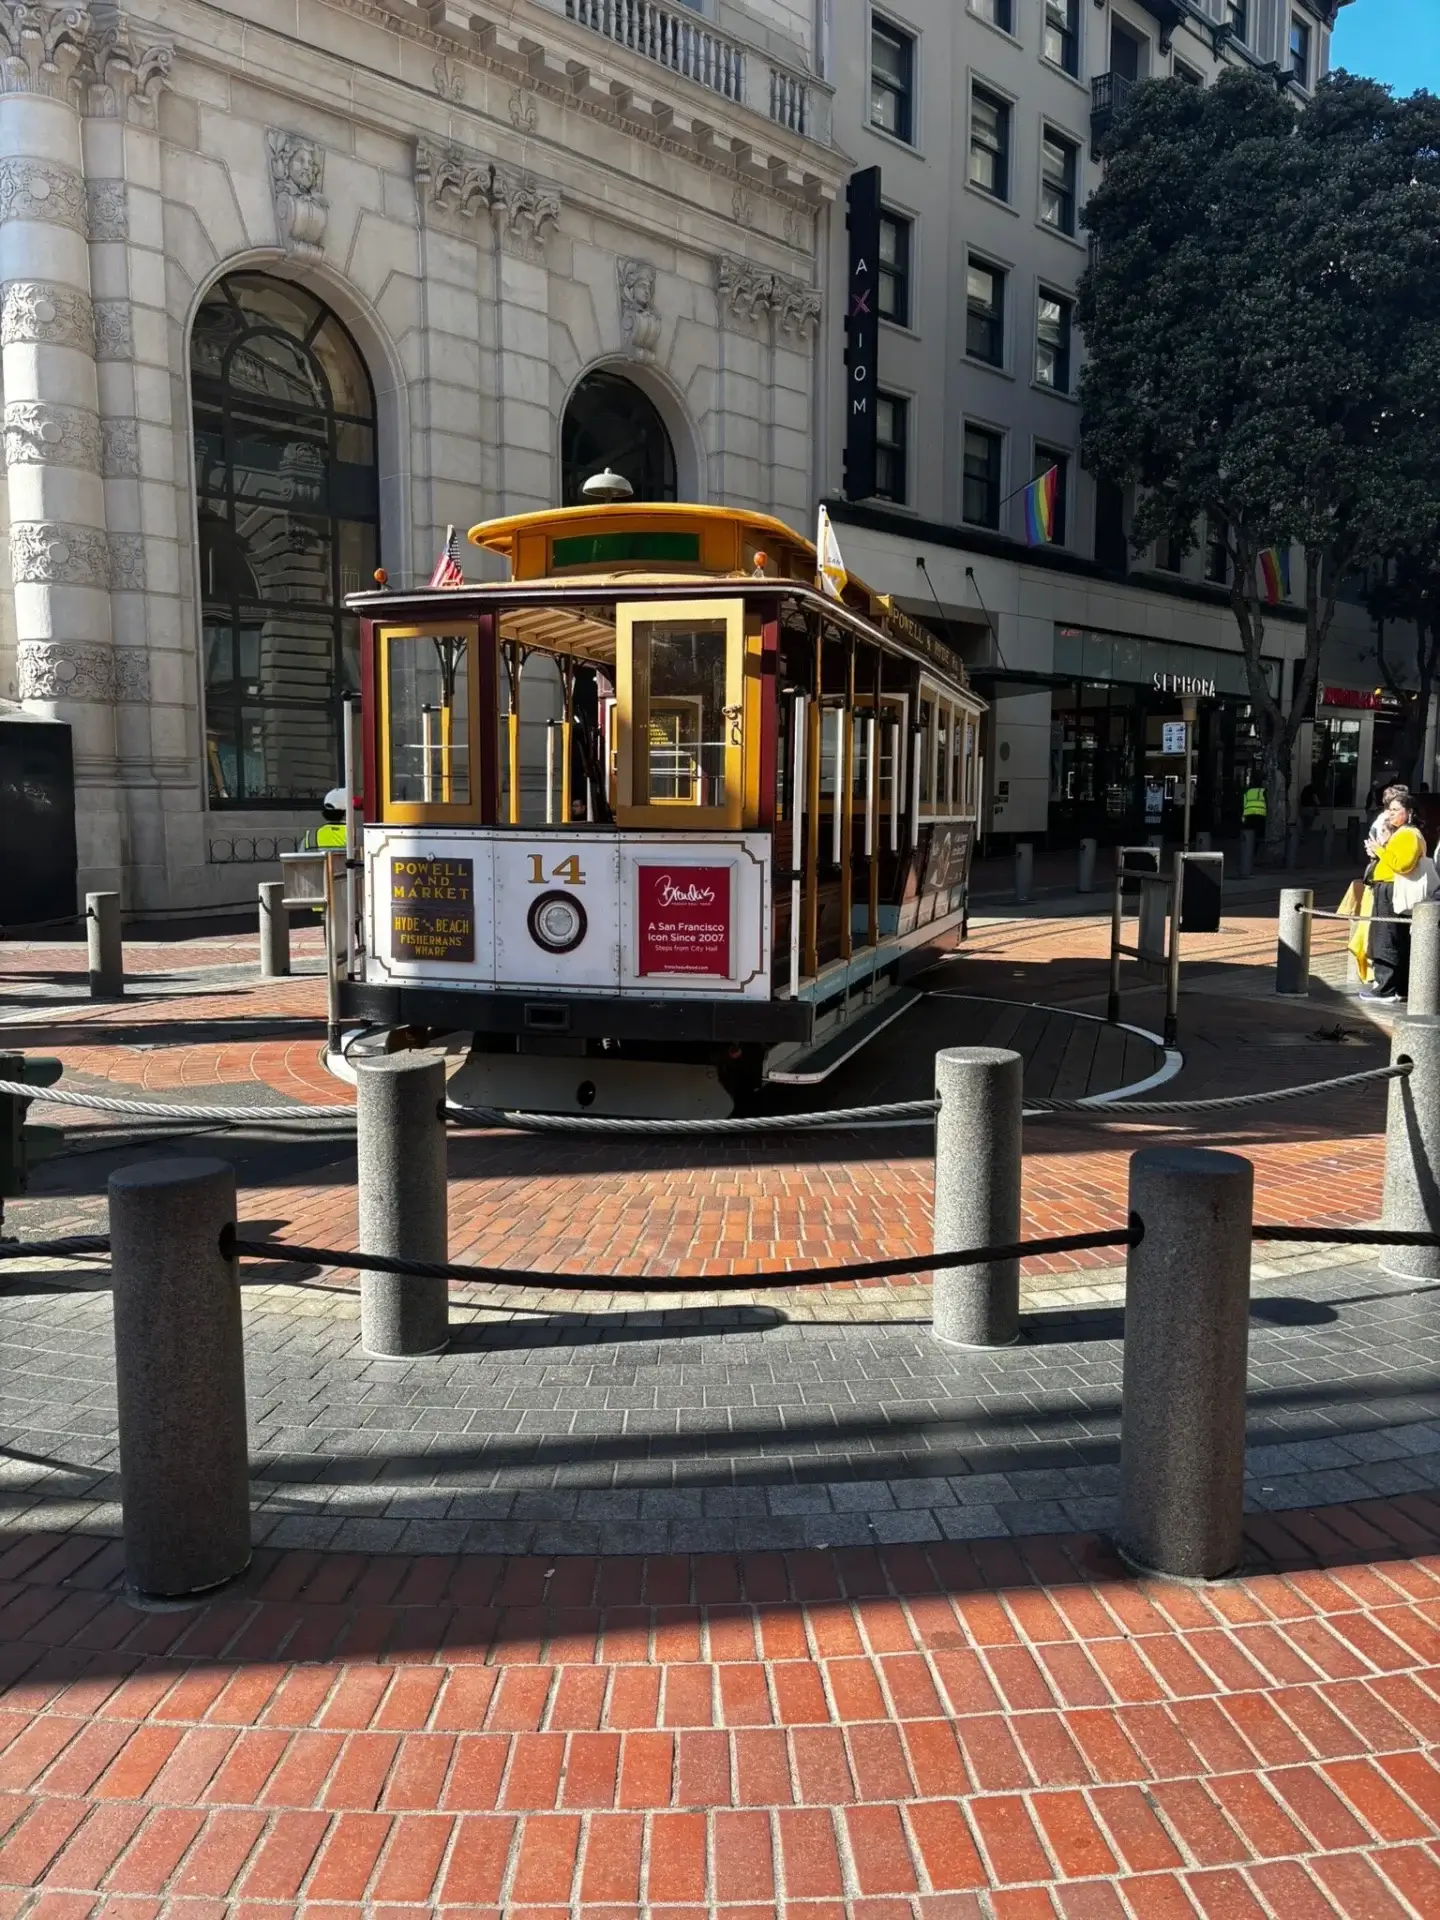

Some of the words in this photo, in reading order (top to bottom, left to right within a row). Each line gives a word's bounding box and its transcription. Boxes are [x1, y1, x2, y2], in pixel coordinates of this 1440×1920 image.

[852, 258, 871, 415] AXIOM
[893, 608, 923, 645] POWELL
[1153, 672, 1216, 698] SEPHORA
[393, 862, 468, 876] POWELL
[526, 853, 587, 885] 14
[414, 876, 450, 886] AND
[393, 886, 470, 900] MARKET
[394, 916, 421, 932] HYDE
[436, 918, 470, 934] BEACH
[648, 922, 656, 931] A
[658, 922, 676, 931] San
[678, 922, 725, 932] Francisco
[400, 934, 462, 947] FISHERMANS
[648, 933, 668, 942] Icon
[670, 933, 697, 942] Since
[415, 946, 448, 957] WHARF
[655, 944, 673, 952] Steps
[690, 945, 704, 953] City
